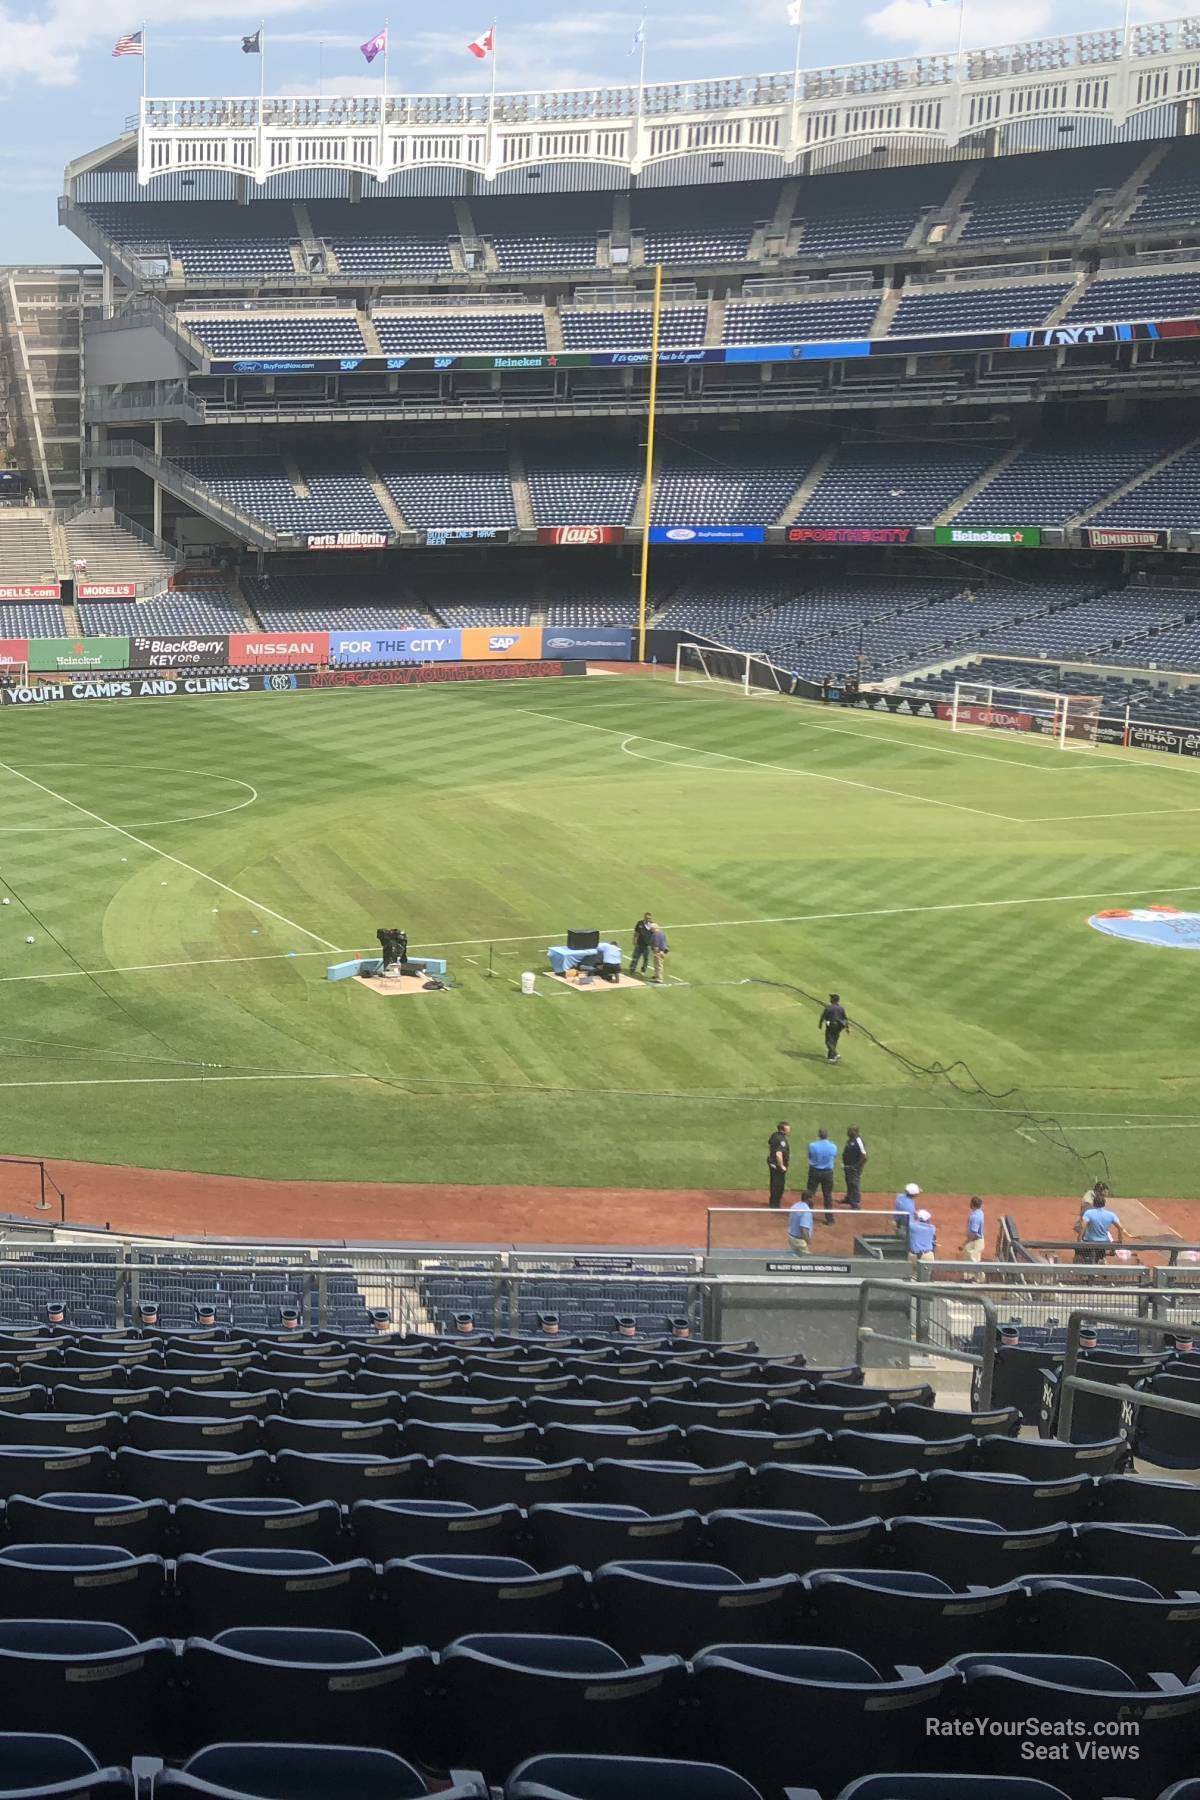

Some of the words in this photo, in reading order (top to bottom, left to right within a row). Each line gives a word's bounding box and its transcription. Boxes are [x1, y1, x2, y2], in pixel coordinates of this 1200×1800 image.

[340, 360, 359, 370] SAP
[387, 359, 406, 369] SAP
[434, 358, 453, 368] SAP
[494, 357, 542, 368] Heineken
[308, 533, 336, 546] Parts
[336, 531, 387, 546] Authority
[951, 530, 1012, 542] Heineken
[82, 586, 130, 596] MODELL'S
[245, 642, 315, 655] NISSAN
[339, 641, 372, 654] FOR
[376, 640, 406, 652] THE
[489, 637, 515, 649] SAP
[6, 685, 65, 703] YOUTH
[71, 682, 133, 699] CAMPS
[139, 680, 178, 696] AND
[184, 677, 251, 693] CLINICS
[1134, 731, 1178, 746] ETIHAD
